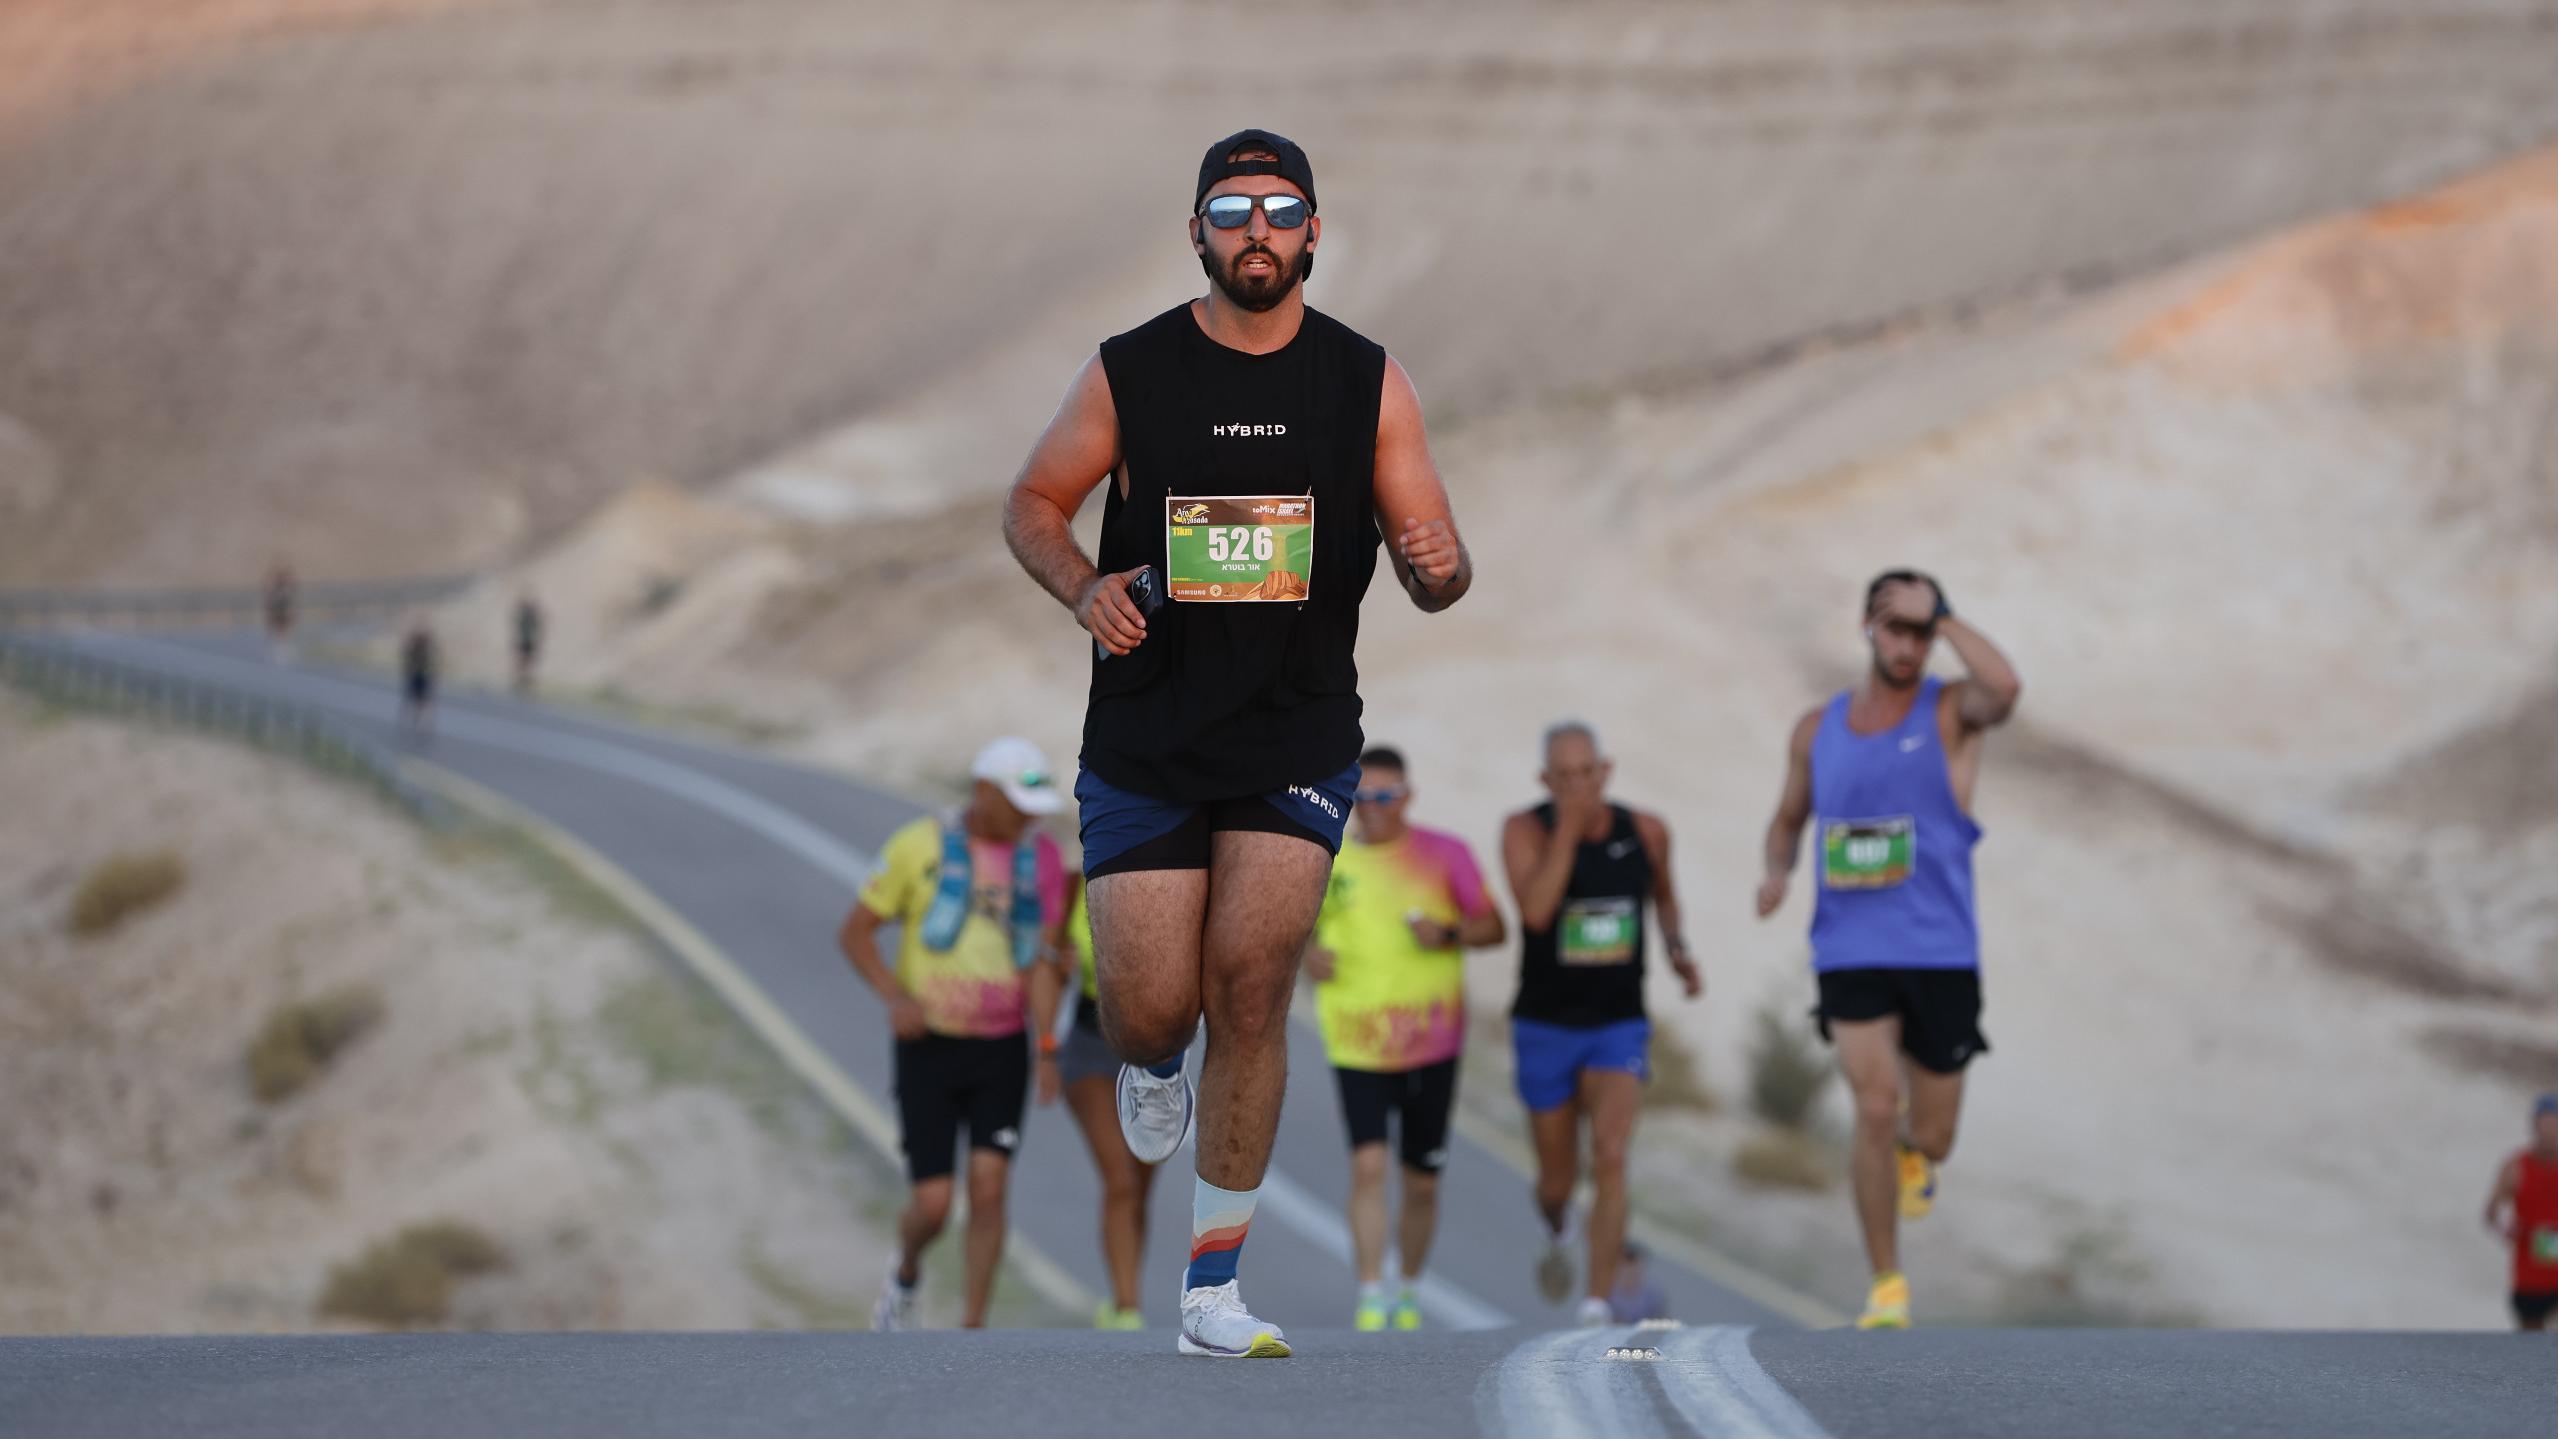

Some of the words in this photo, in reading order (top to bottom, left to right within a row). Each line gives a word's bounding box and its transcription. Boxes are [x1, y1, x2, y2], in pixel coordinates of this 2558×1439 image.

[1213, 423, 1287, 437] HYBRID
[1208, 527, 1273, 561] 526
[1288, 784, 1339, 819] HYBRID
